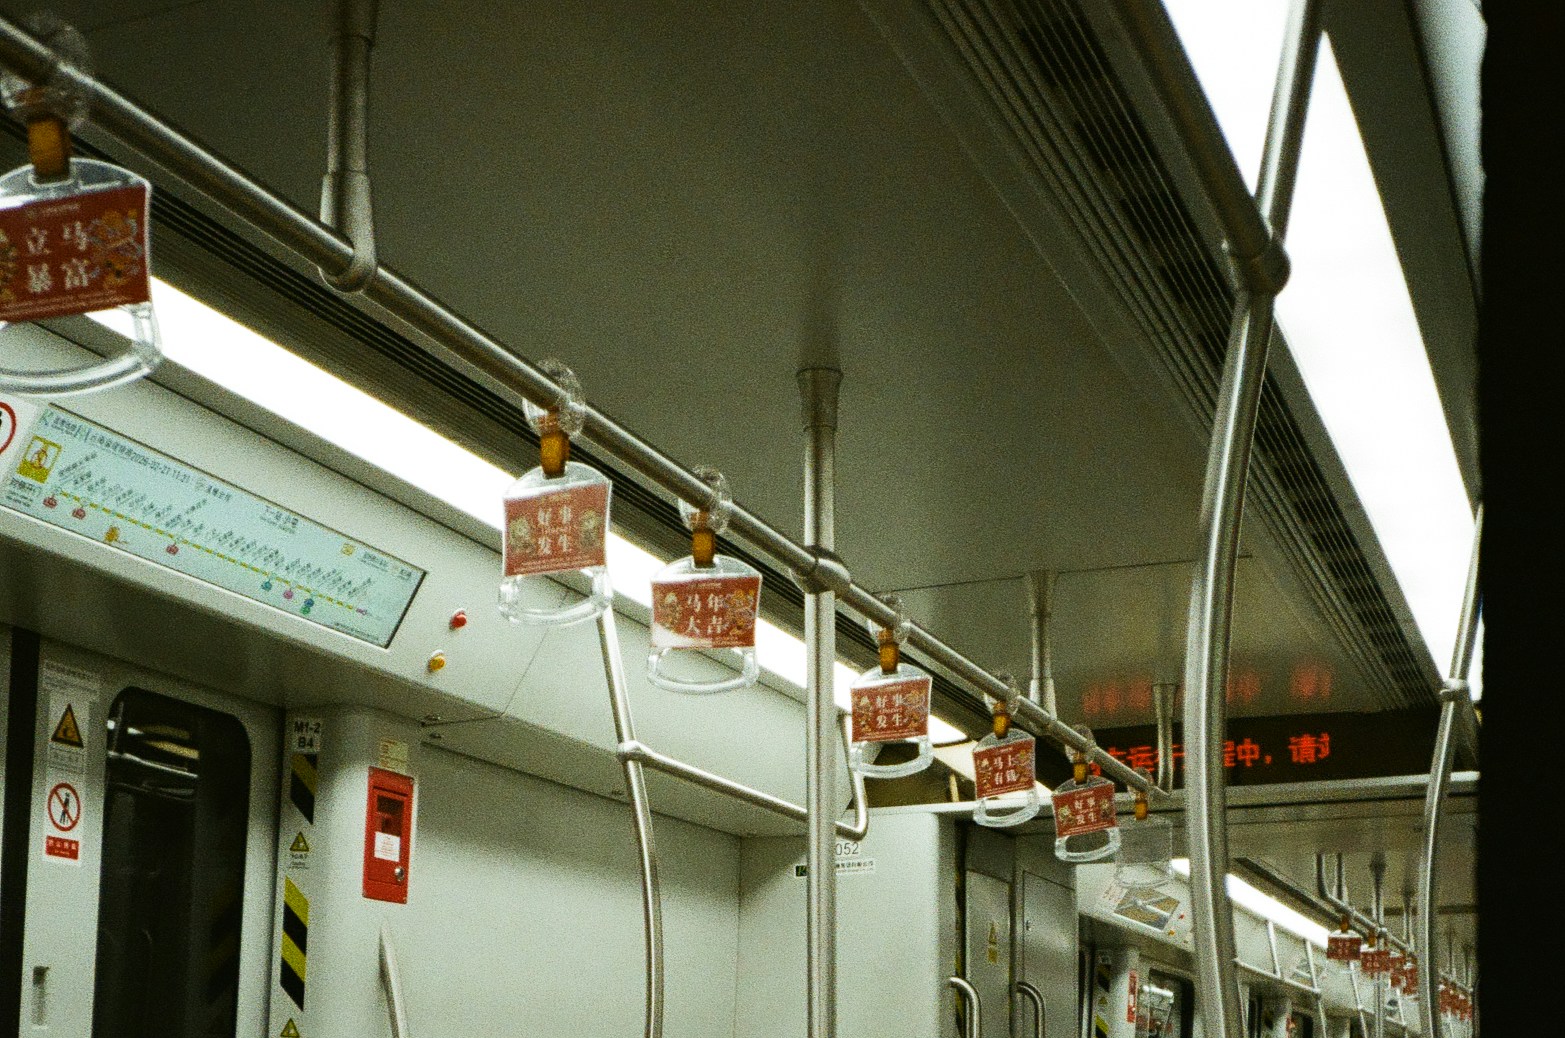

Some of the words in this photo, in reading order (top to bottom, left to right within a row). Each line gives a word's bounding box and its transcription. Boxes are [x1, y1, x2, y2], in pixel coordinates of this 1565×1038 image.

[26, 258, 89, 293] 暴富
[538, 505, 571, 526] 好事
[538, 534, 571, 555] 发生
[876, 693, 903, 708] 好事
[293, 719, 322, 735] M1-2
[876, 714, 902, 729] 发生
